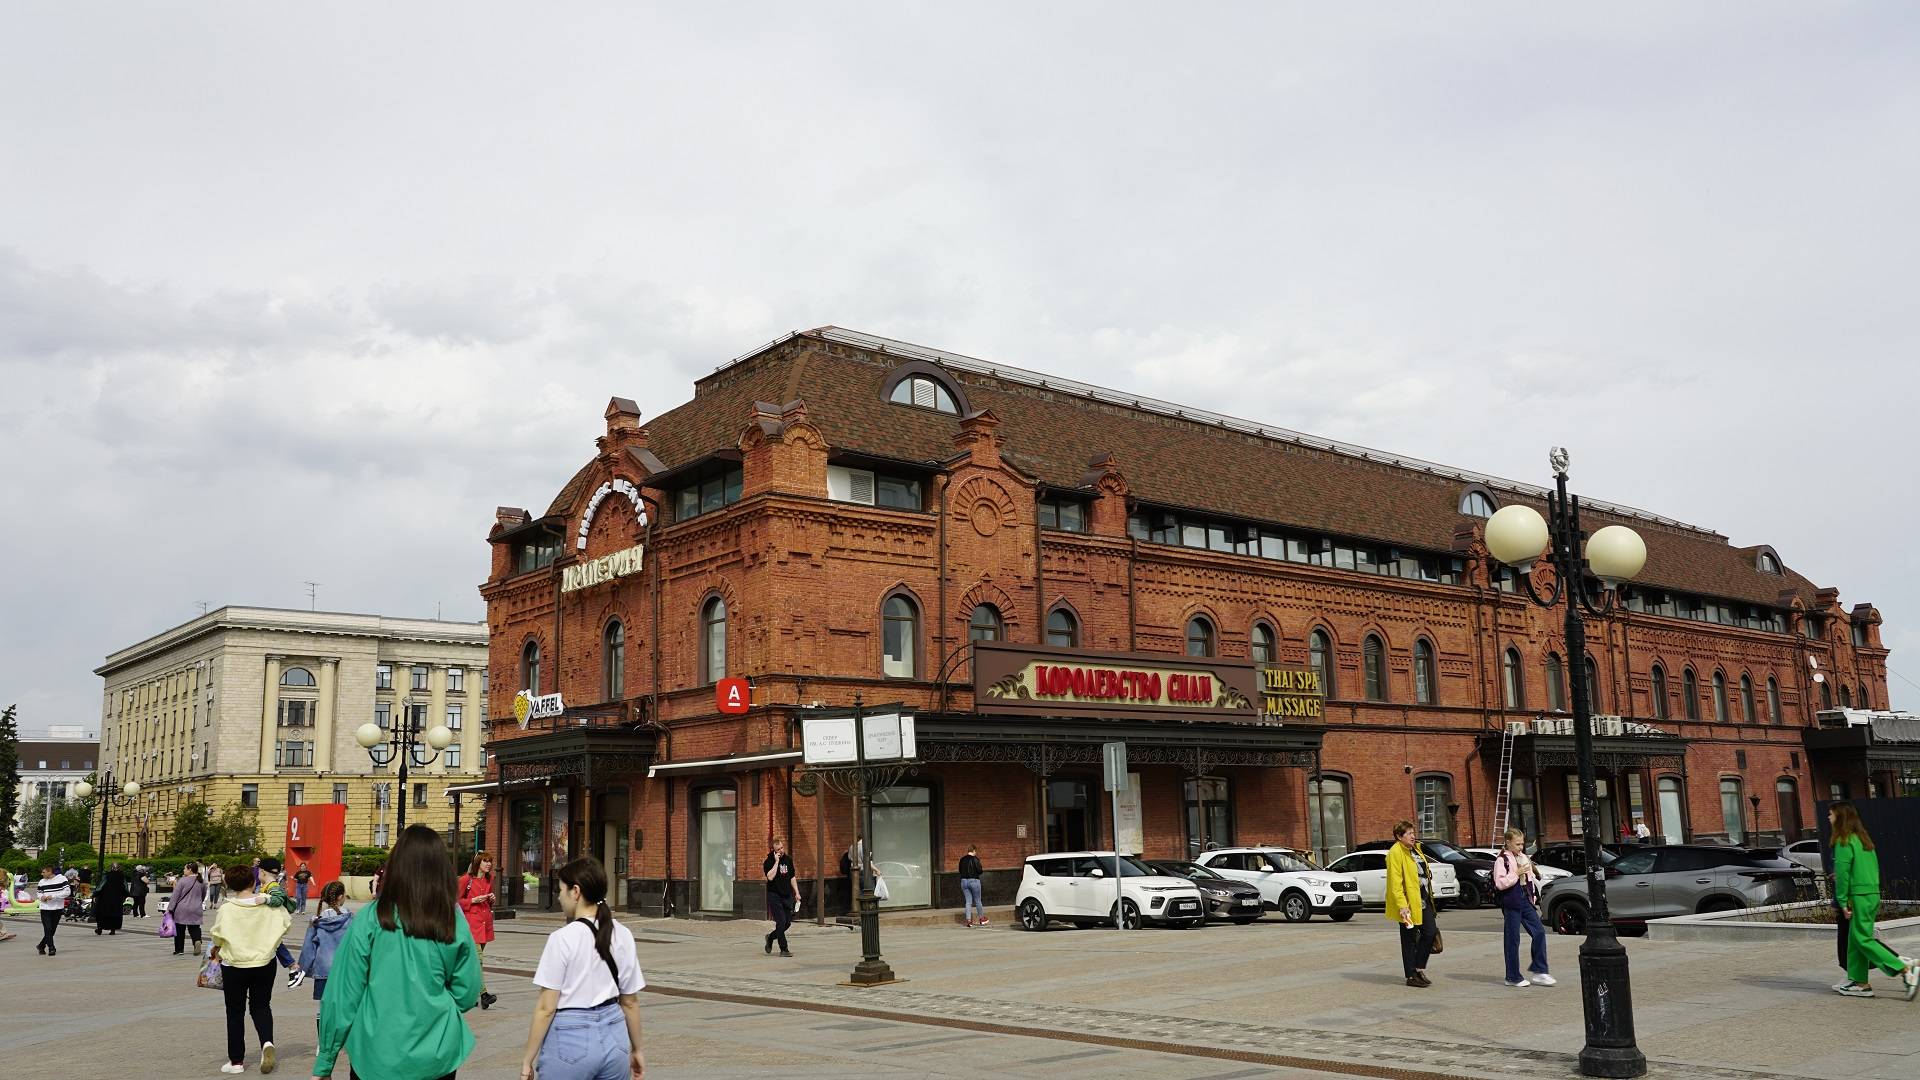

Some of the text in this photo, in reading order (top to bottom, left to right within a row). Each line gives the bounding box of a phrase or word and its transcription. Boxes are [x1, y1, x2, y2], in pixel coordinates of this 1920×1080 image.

[561, 544, 644, 593] ИМПЕРИЯ
[1034, 665, 1213, 703] КОРОЛЕВСТВО СИАМ
[1265, 669, 1318, 690] THAI SPA
[1266, 697, 1321, 717] MASSAGE
